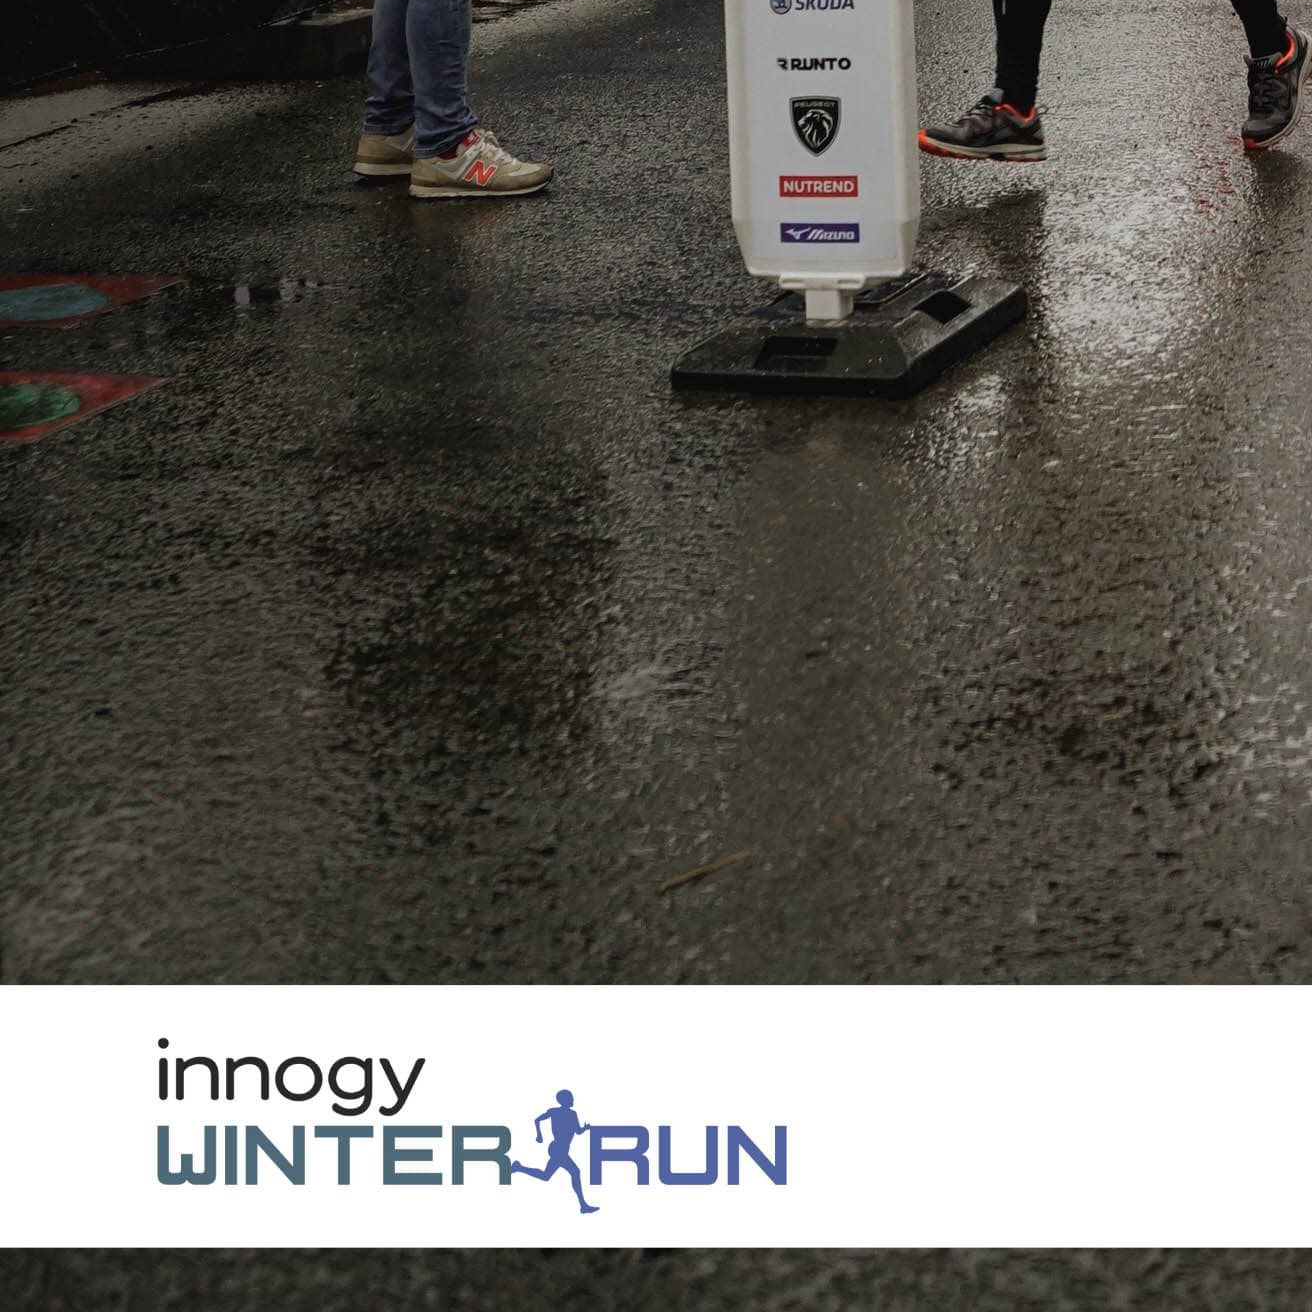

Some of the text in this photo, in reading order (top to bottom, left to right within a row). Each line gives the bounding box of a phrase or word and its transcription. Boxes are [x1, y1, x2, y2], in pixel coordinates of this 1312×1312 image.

[790, 57, 851, 71] RUNTO
[794, 100, 836, 109] PEUGEOT
[783, 179, 855, 193] NUTREND
